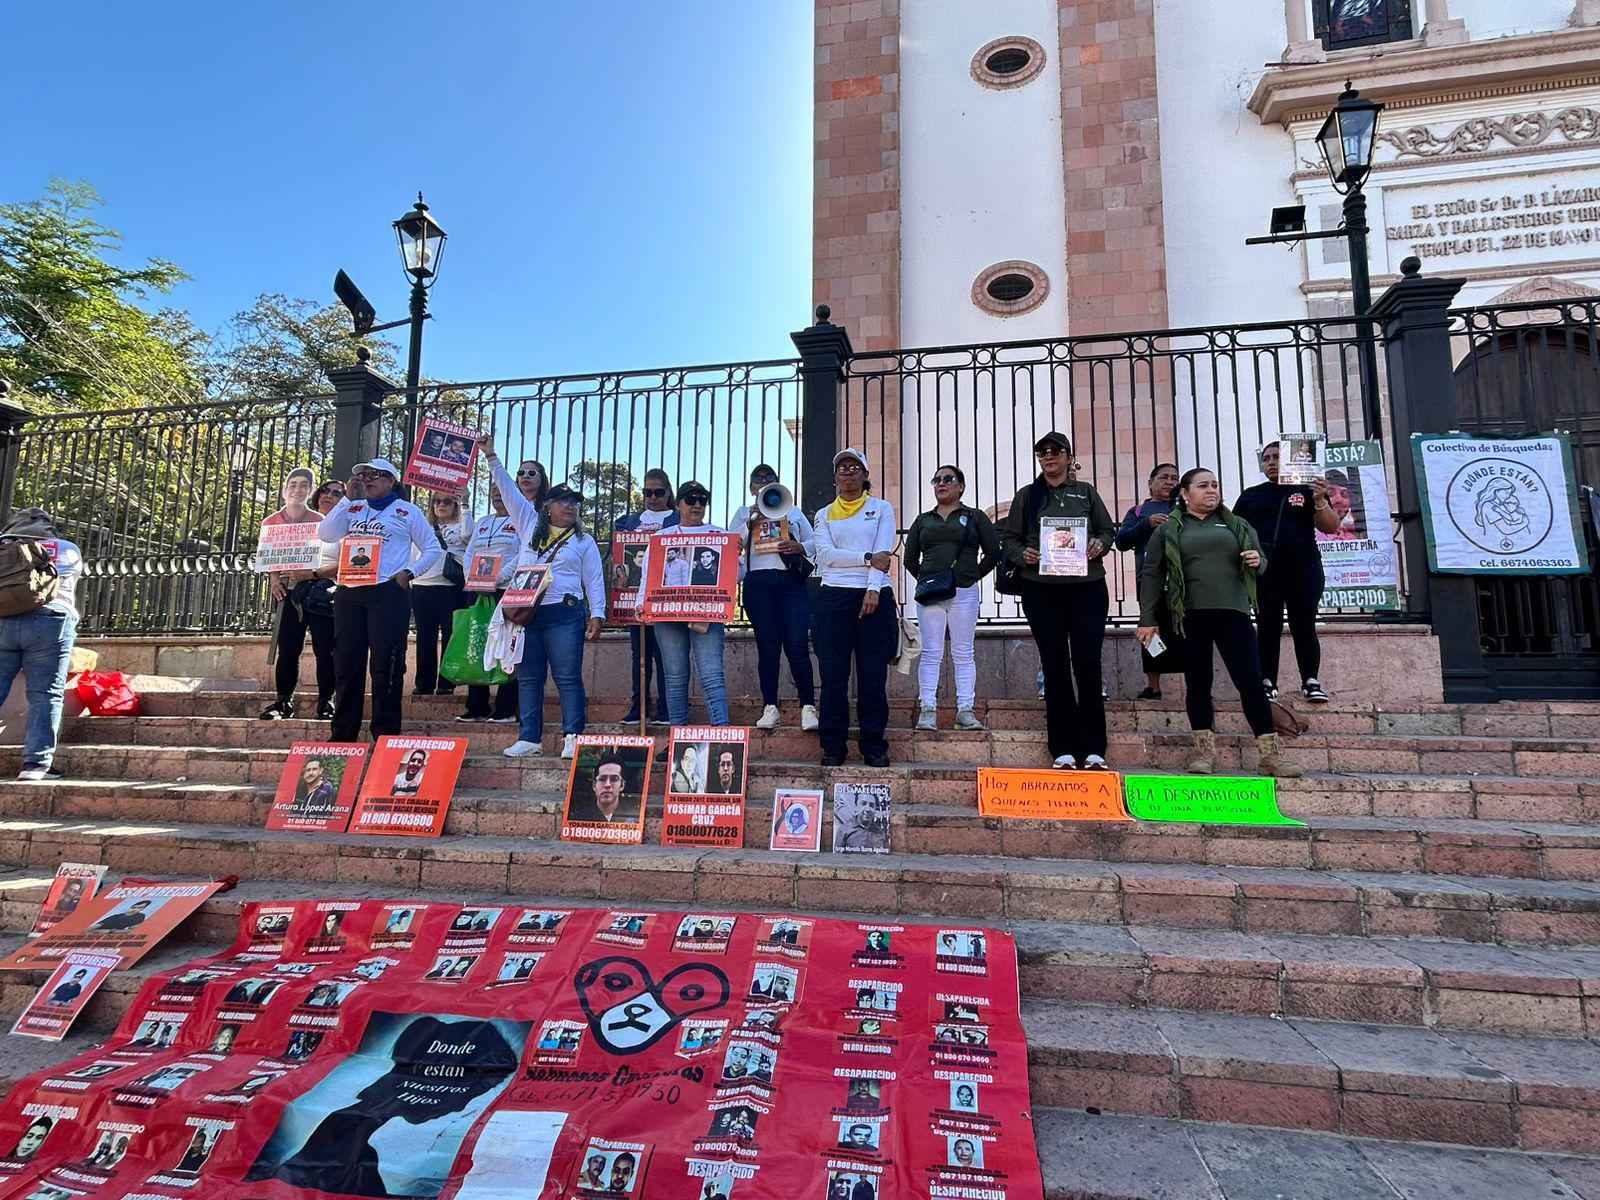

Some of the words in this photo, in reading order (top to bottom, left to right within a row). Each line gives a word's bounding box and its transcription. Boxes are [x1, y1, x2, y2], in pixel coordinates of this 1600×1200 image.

[1452, 207, 1564, 234] BALLESTEROS
[1411, 239, 1474, 258] TEMPLO
[1503, 234, 1522, 250] 22
[425, 418, 481, 438] DESAPARECIDO
[1325, 442, 1366, 463] ESTÁ?
[1427, 443, 1477, 453] Colectivo
[1479, 443, 1491, 453] de
[1493, 442, 1553, 454] Búsquedas
[1461, 466, 1496, 493] ¿DÓNDE
[1499, 466, 1539, 494] ESTÁN?
[268, 524, 317, 536] DESAPARECIDO
[616, 533, 651, 544] DESAPAR
[661, 536, 729, 546] DESAPARECIDO
[1336, 540, 1359, 553] LÓPEZ
[1360, 539, 1379, 551] PIÑA
[1480, 559, 1499, 568] Cel.
[1500, 558, 1572, 568] 6674063303
[651, 603, 662, 613] 01
[663, 602, 682, 613] 800
[674, 728, 745, 741] DESAPARECIDO
[386, 739, 456, 750] DESAPARECIDO
[577, 736, 655, 747] DESAPARECIDO
[292, 746, 365, 757] DESAPARECIDO
[838, 786, 887, 795] DESAPARECIDO
[1021, 782, 1089, 793] ABRAZAMOS
[1136, 788, 1155, 801] LA
[274, 802, 298, 811] Arturo
[325, 804, 350, 813] Arana
[991, 797, 1040, 807] QUIENES
[1048, 799, 1089, 808] TIENEN
[667, 804, 706, 814] YOSIMAR
[707, 804, 741, 815] GARCÍA
[360, 813, 371, 824] 01
[371, 813, 390, 824] 800
[390, 814, 434, 827] 6703600
[568, 821, 596, 829] YOSIMAR
[691, 815, 715, 825] CRUZ
[562, 826, 641, 840] 018006703600
[667, 825, 738, 838] 01800077628
[104, 885, 209, 899] DESAPARECIDO
[315, 902, 361, 912] DESAPARECIDO
[857, 924, 904, 932] DESAPARECIDO
[848, 979, 904, 993] DESAPARECIDO
[936, 993, 990, 1006] DESAPARECIDA
[681, 1019, 729, 1028] DESAPARECIDO
[427, 1040, 476, 1055] Donde
[424, 1064, 465, 1077] estan
[834, 1067, 897, 1080] DESAPARECIDO
[934, 1069, 993, 1083] DESAPARECIDO
[396, 1080, 470, 1093] Nuestros
[397, 1092, 441, 1105] Hijos
[21, 1103, 79, 1120] DESAPARECIDO
[708, 1098, 770, 1115] DESAPARECIDO
[96, 1121, 145, 1134] DESAPARECIDO
[955, 1120, 970, 1129] 157
[589, 1137, 646, 1151] DESAPARECIDO
[687, 1161, 754, 1179] DESAPARECIDO
[956, 1174, 972, 1182] 157
